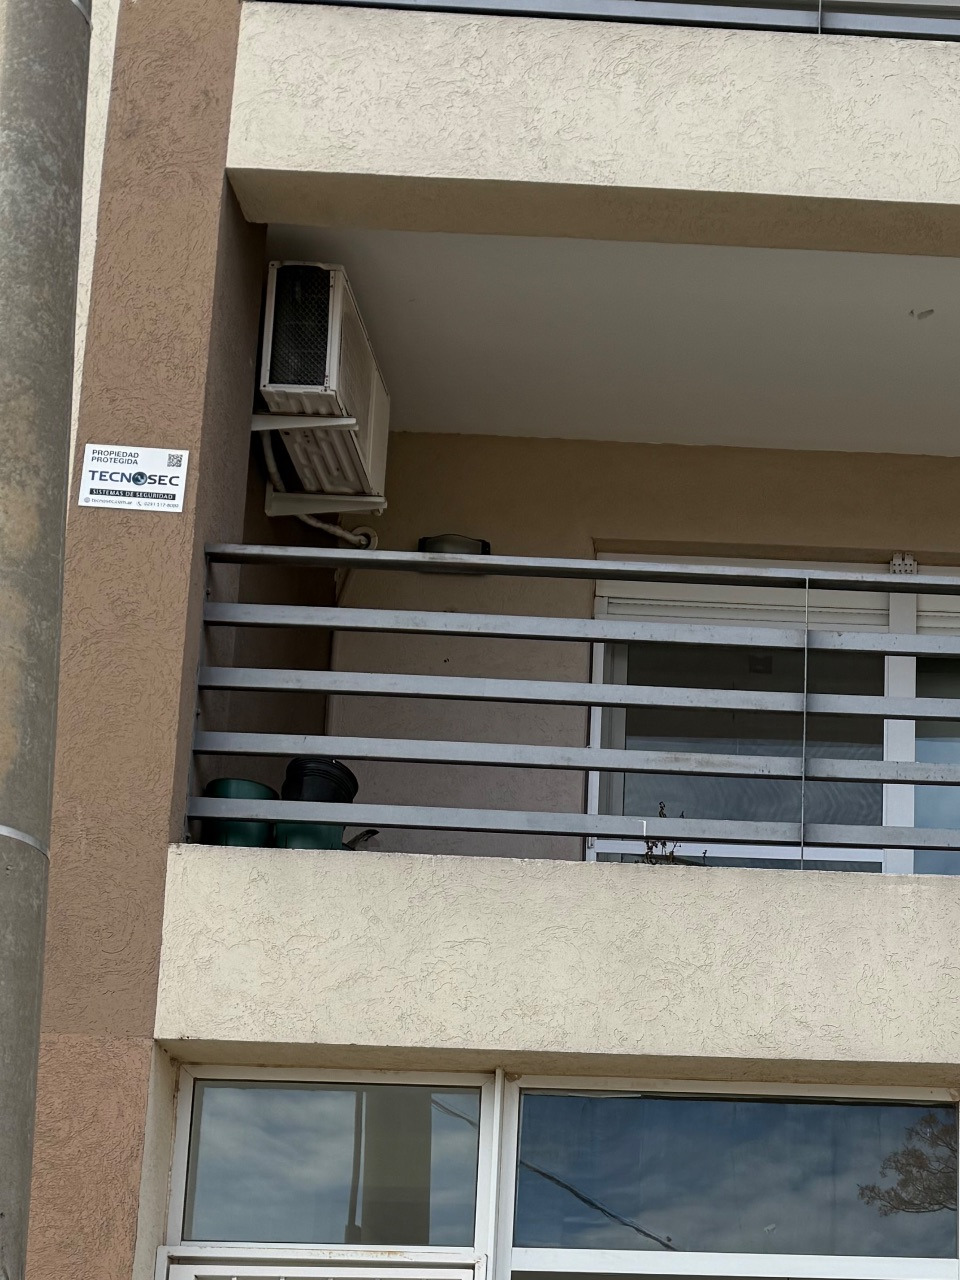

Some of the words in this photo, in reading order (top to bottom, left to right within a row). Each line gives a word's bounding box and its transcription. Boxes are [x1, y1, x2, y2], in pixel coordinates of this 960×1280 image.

[91, 449, 139, 459] PROPIEDAD
[91, 456, 138, 465] PROTEGIDA
[88, 470, 180, 486] TECNOSEC
[92, 489, 124, 497] SISTEMAS
[136, 492, 174, 500] SEGURIDAD
